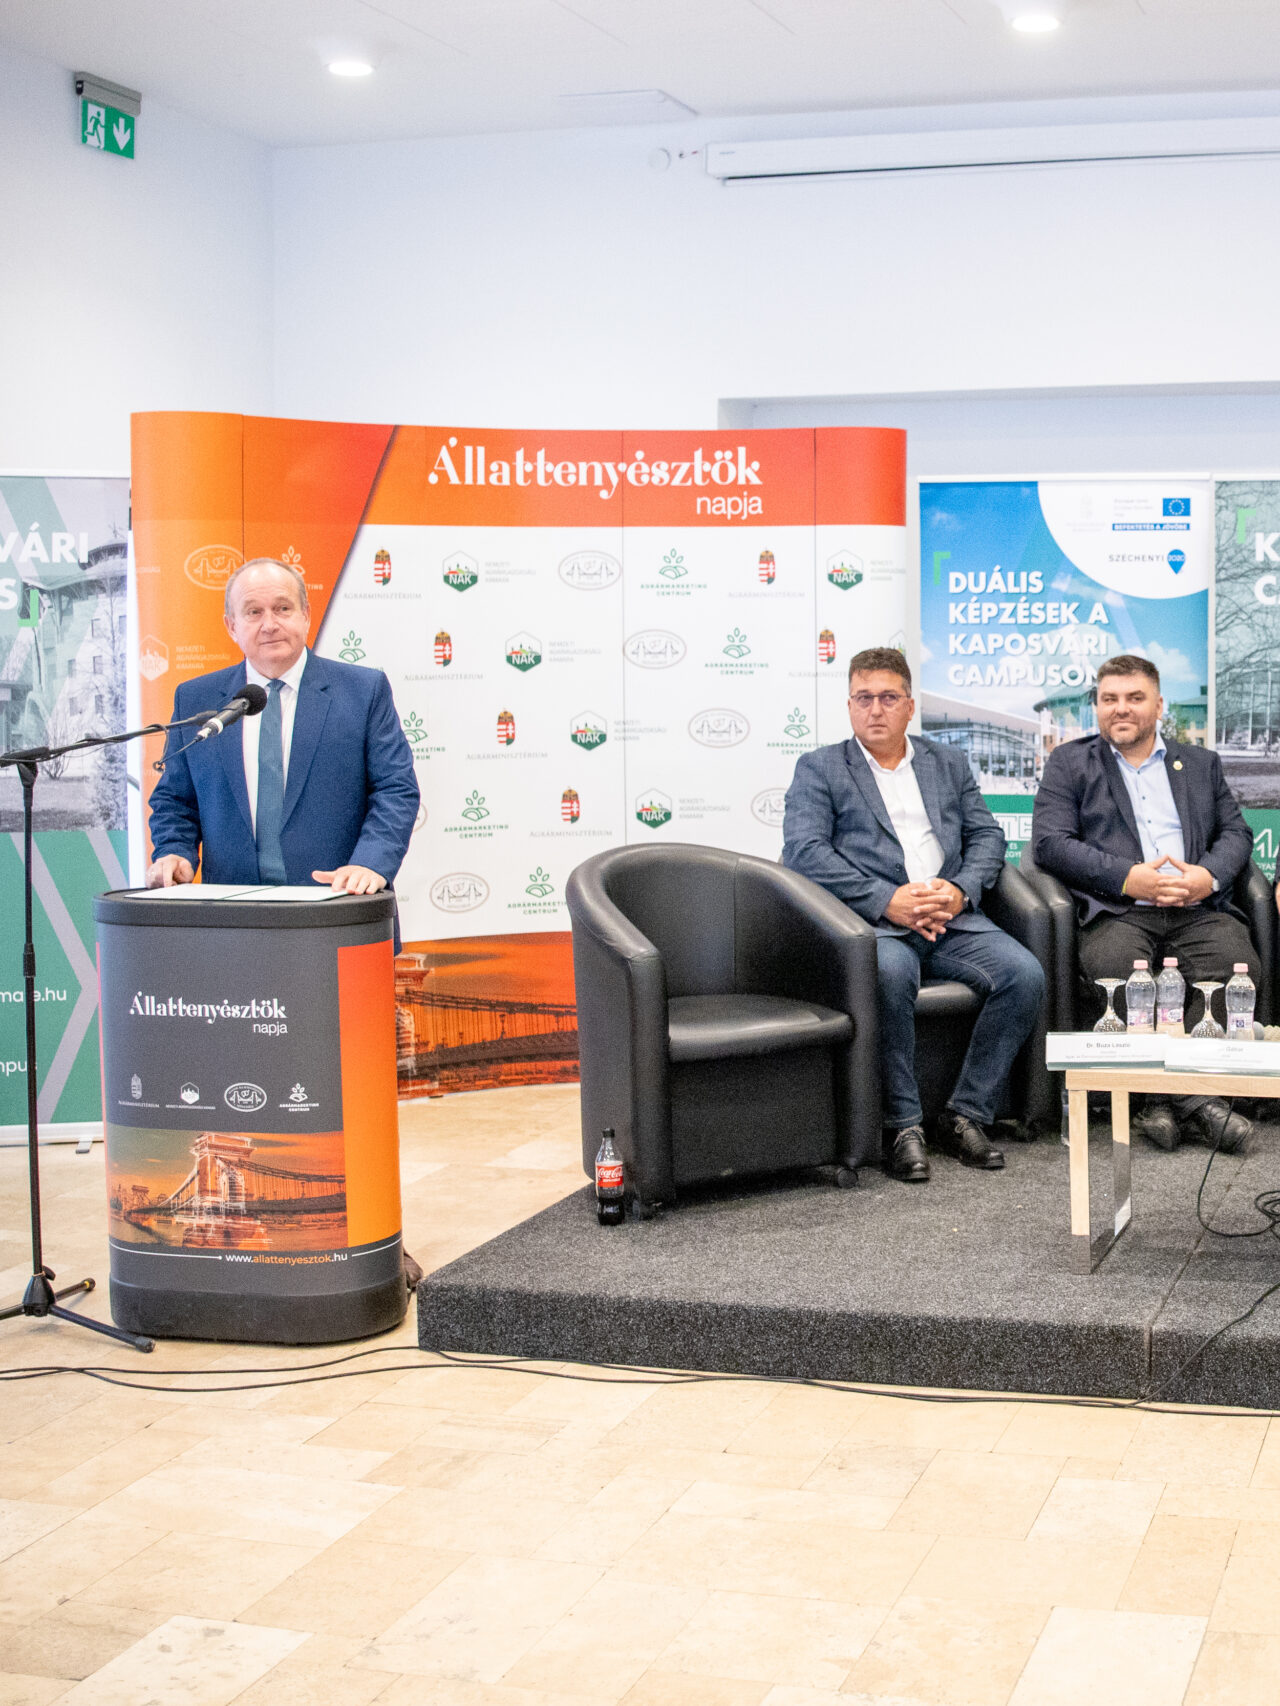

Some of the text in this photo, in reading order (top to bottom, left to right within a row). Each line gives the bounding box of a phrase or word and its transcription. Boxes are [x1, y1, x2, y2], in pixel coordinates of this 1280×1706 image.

[696, 491, 763, 520] napja
[1108, 553, 1164, 562] SZÉCHENYI
[449, 575, 472, 585] NAK
[833, 573, 856, 584] NAK
[949, 565, 1044, 594] DUÁLIS
[949, 596, 1109, 624] KÉPZÉSEK A
[949, 627, 1108, 656] KAPOSVÁRI
[512, 655, 535, 665] NAK
[577, 733, 600, 743] NAK
[642, 811, 665, 822] NAK
[253, 1021, 288, 1036] napja
[225, 1253, 348, 1266] www.allattenyesztok.hu
